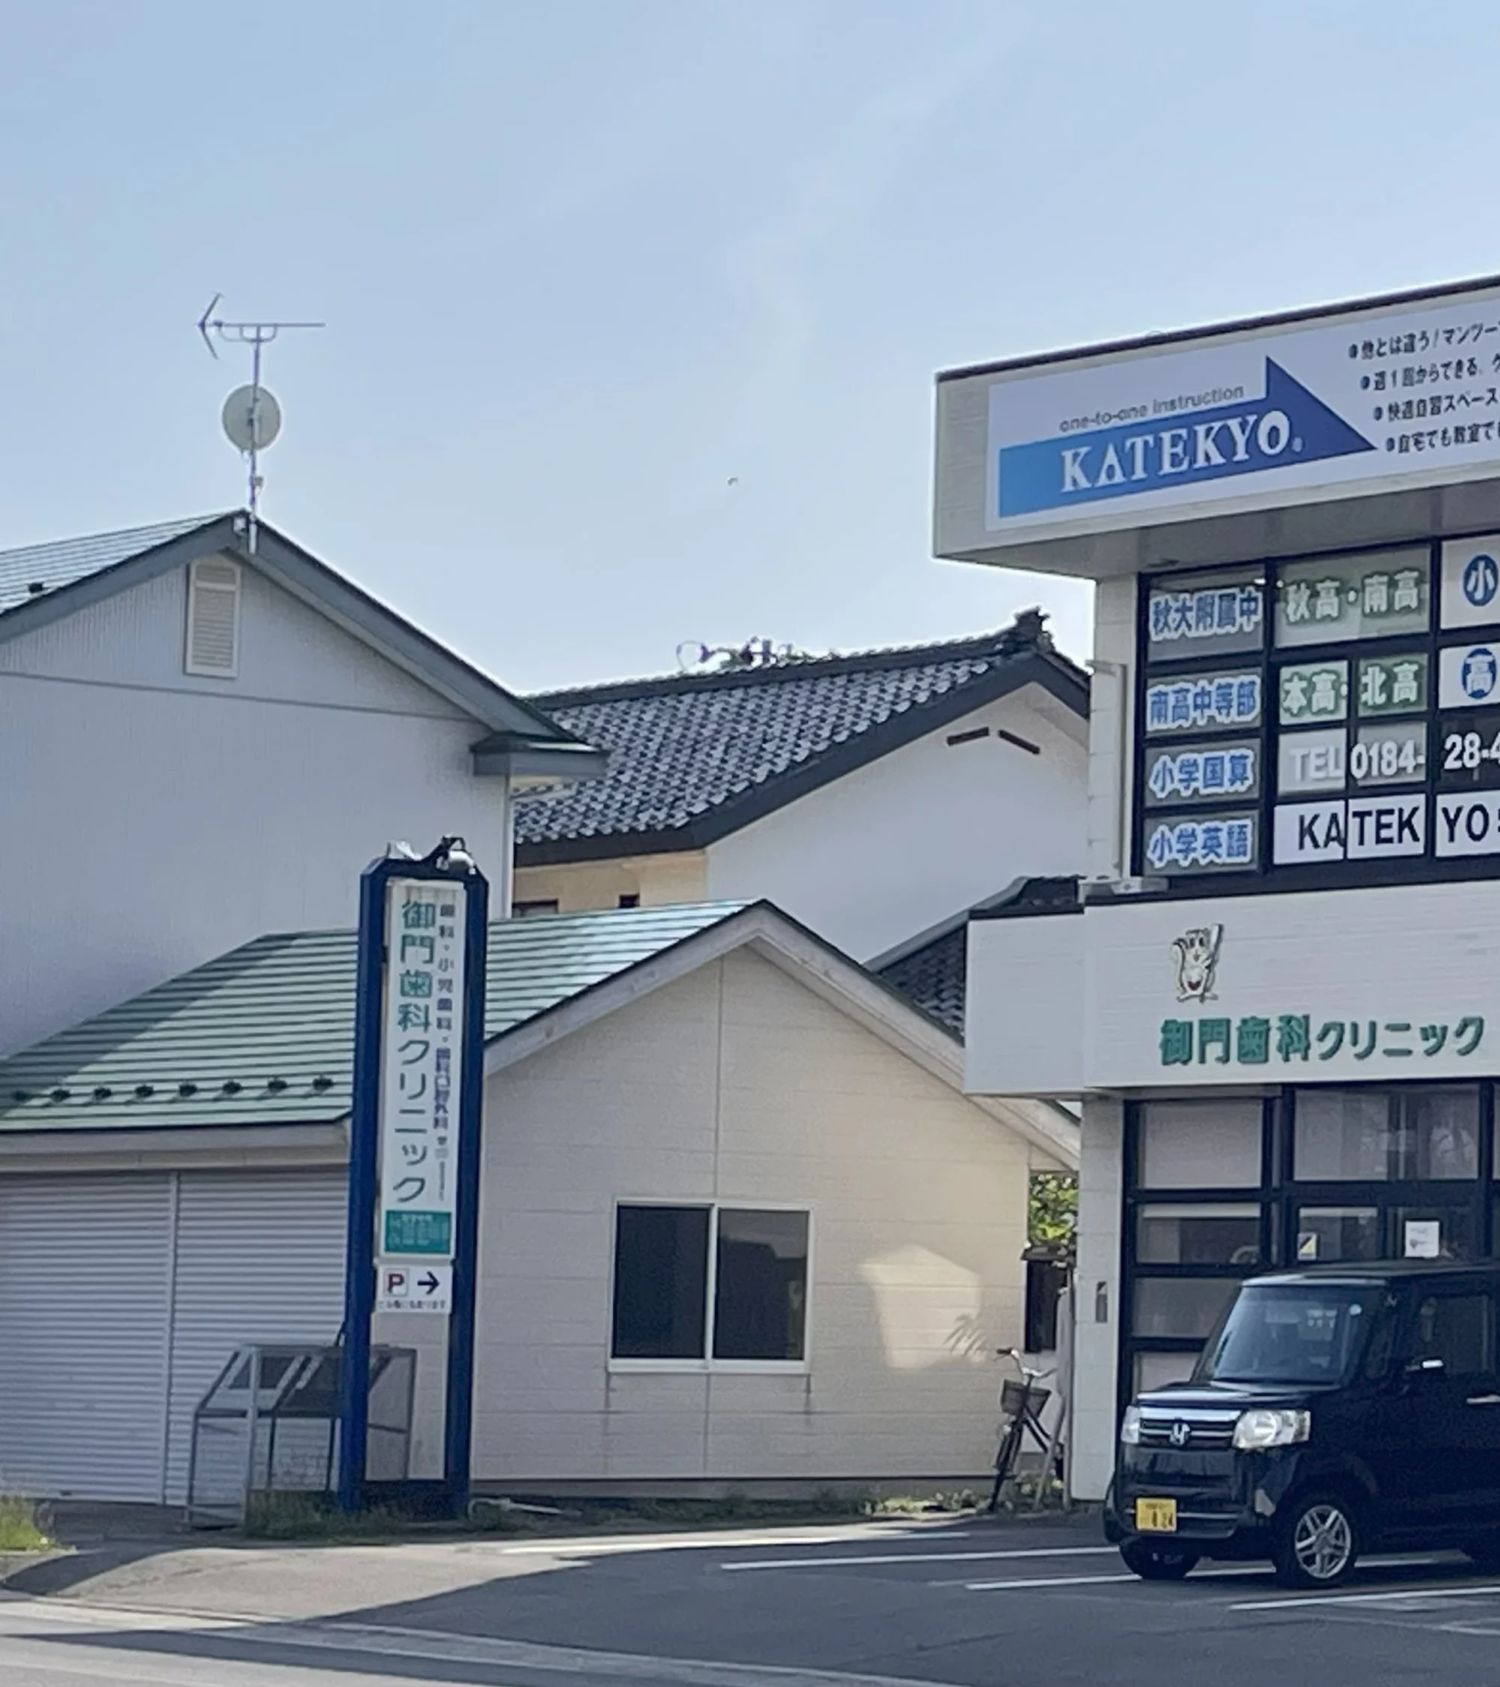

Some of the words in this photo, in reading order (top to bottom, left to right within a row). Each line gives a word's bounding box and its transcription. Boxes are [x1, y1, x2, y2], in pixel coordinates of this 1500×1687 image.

[1059, 404, 1148, 432] one-to-one
[1153, 385, 1244, 415] instruction
[1060, 410, 1291, 493] KATEKYO
[1147, 674, 1260, 730] 南高中等部
[1149, 749, 1254, 798] 小学国算
[1290, 746, 1343, 781] TEL
[1147, 819, 1252, 868] 小学英語
[393, 900, 436, 1203] 御門歯科クリニック
[1159, 1014, 1485, 1066] 御門歯科クリニック
